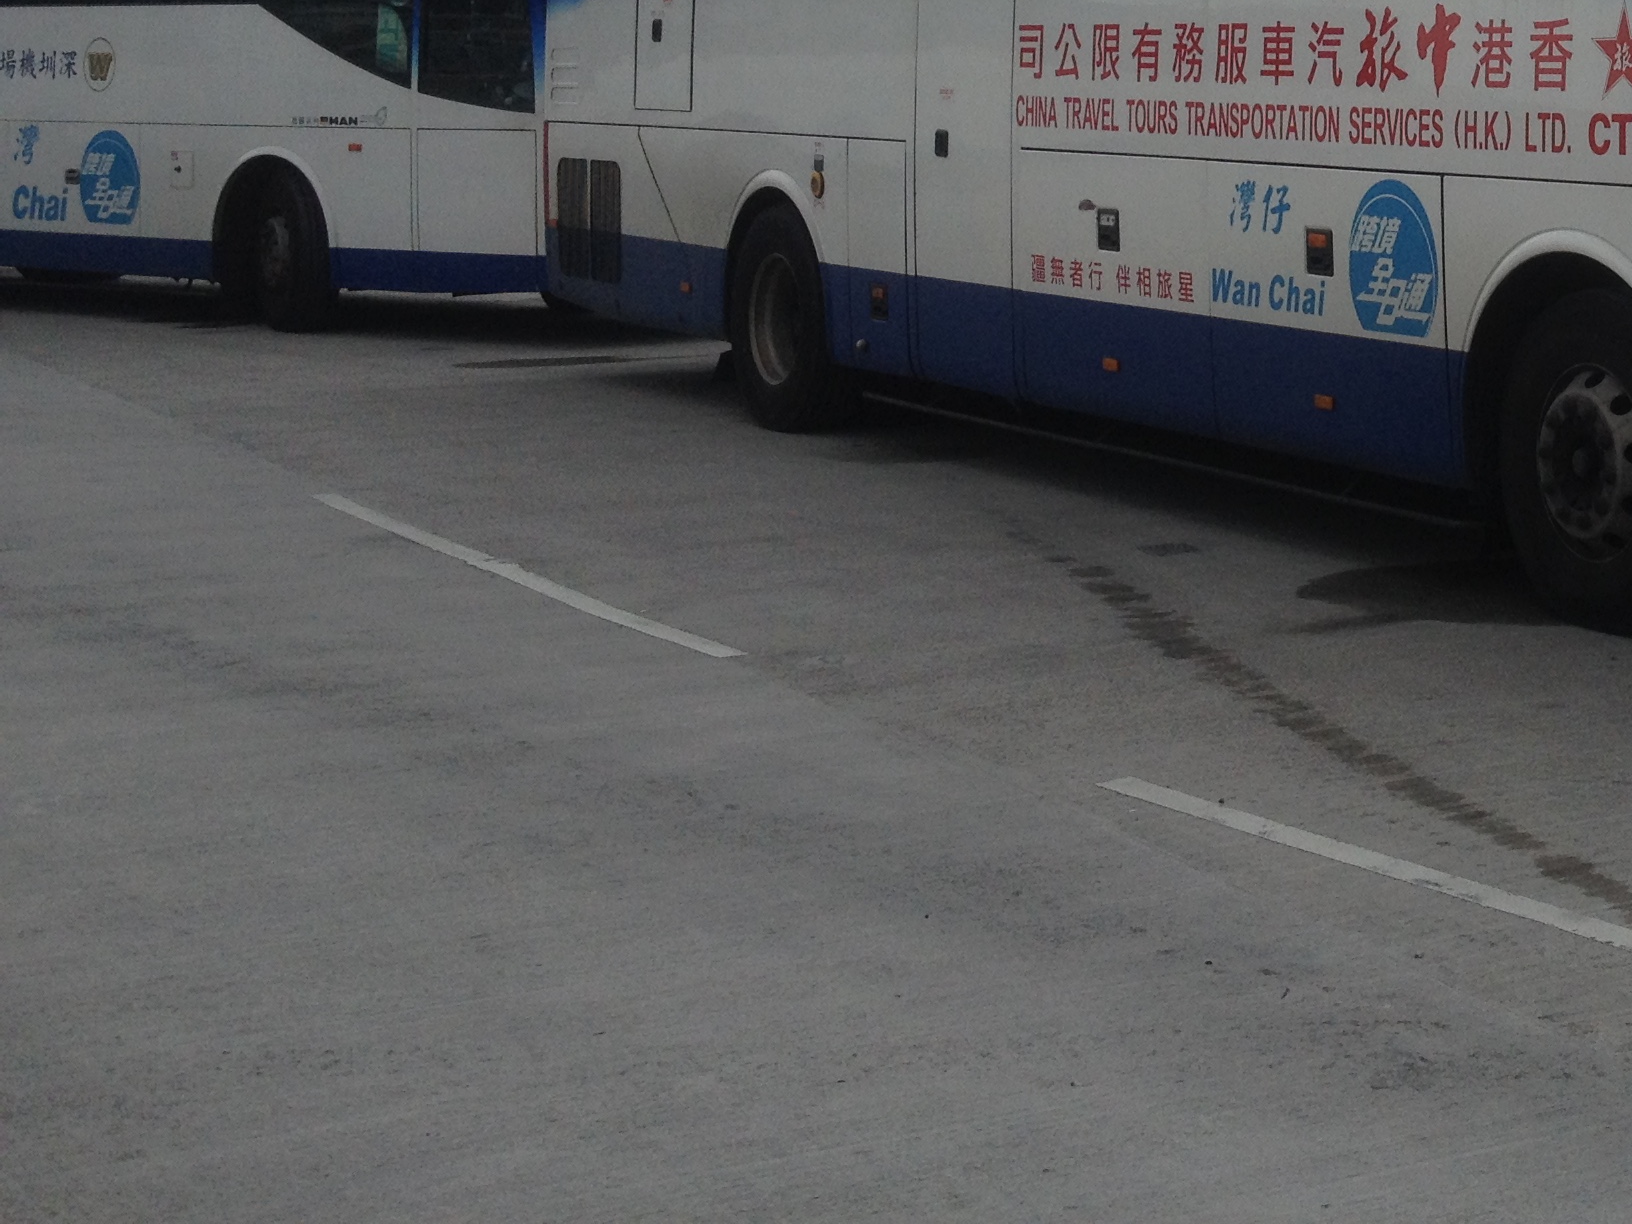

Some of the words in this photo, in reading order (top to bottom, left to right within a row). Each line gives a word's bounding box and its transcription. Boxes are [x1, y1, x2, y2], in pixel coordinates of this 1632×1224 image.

[1016, 95, 1058, 129] CHINA
[1063, 97, 1119, 132] TRAVEL
[1126, 99, 1179, 135] TOURS
[1186, 101, 1340, 144] TRANSPORTATION
[1348, 108, 1444, 148] SERVICES
[1453, 111, 1512, 151] (H.K.)
[1525, 112, 1572, 154] LTD.
[12, 184, 69, 222] Chai
[1229, 181, 1291, 236] 灣仔
[1212, 268, 1260, 307] Wan
[1268, 275, 1325, 318] Chai
